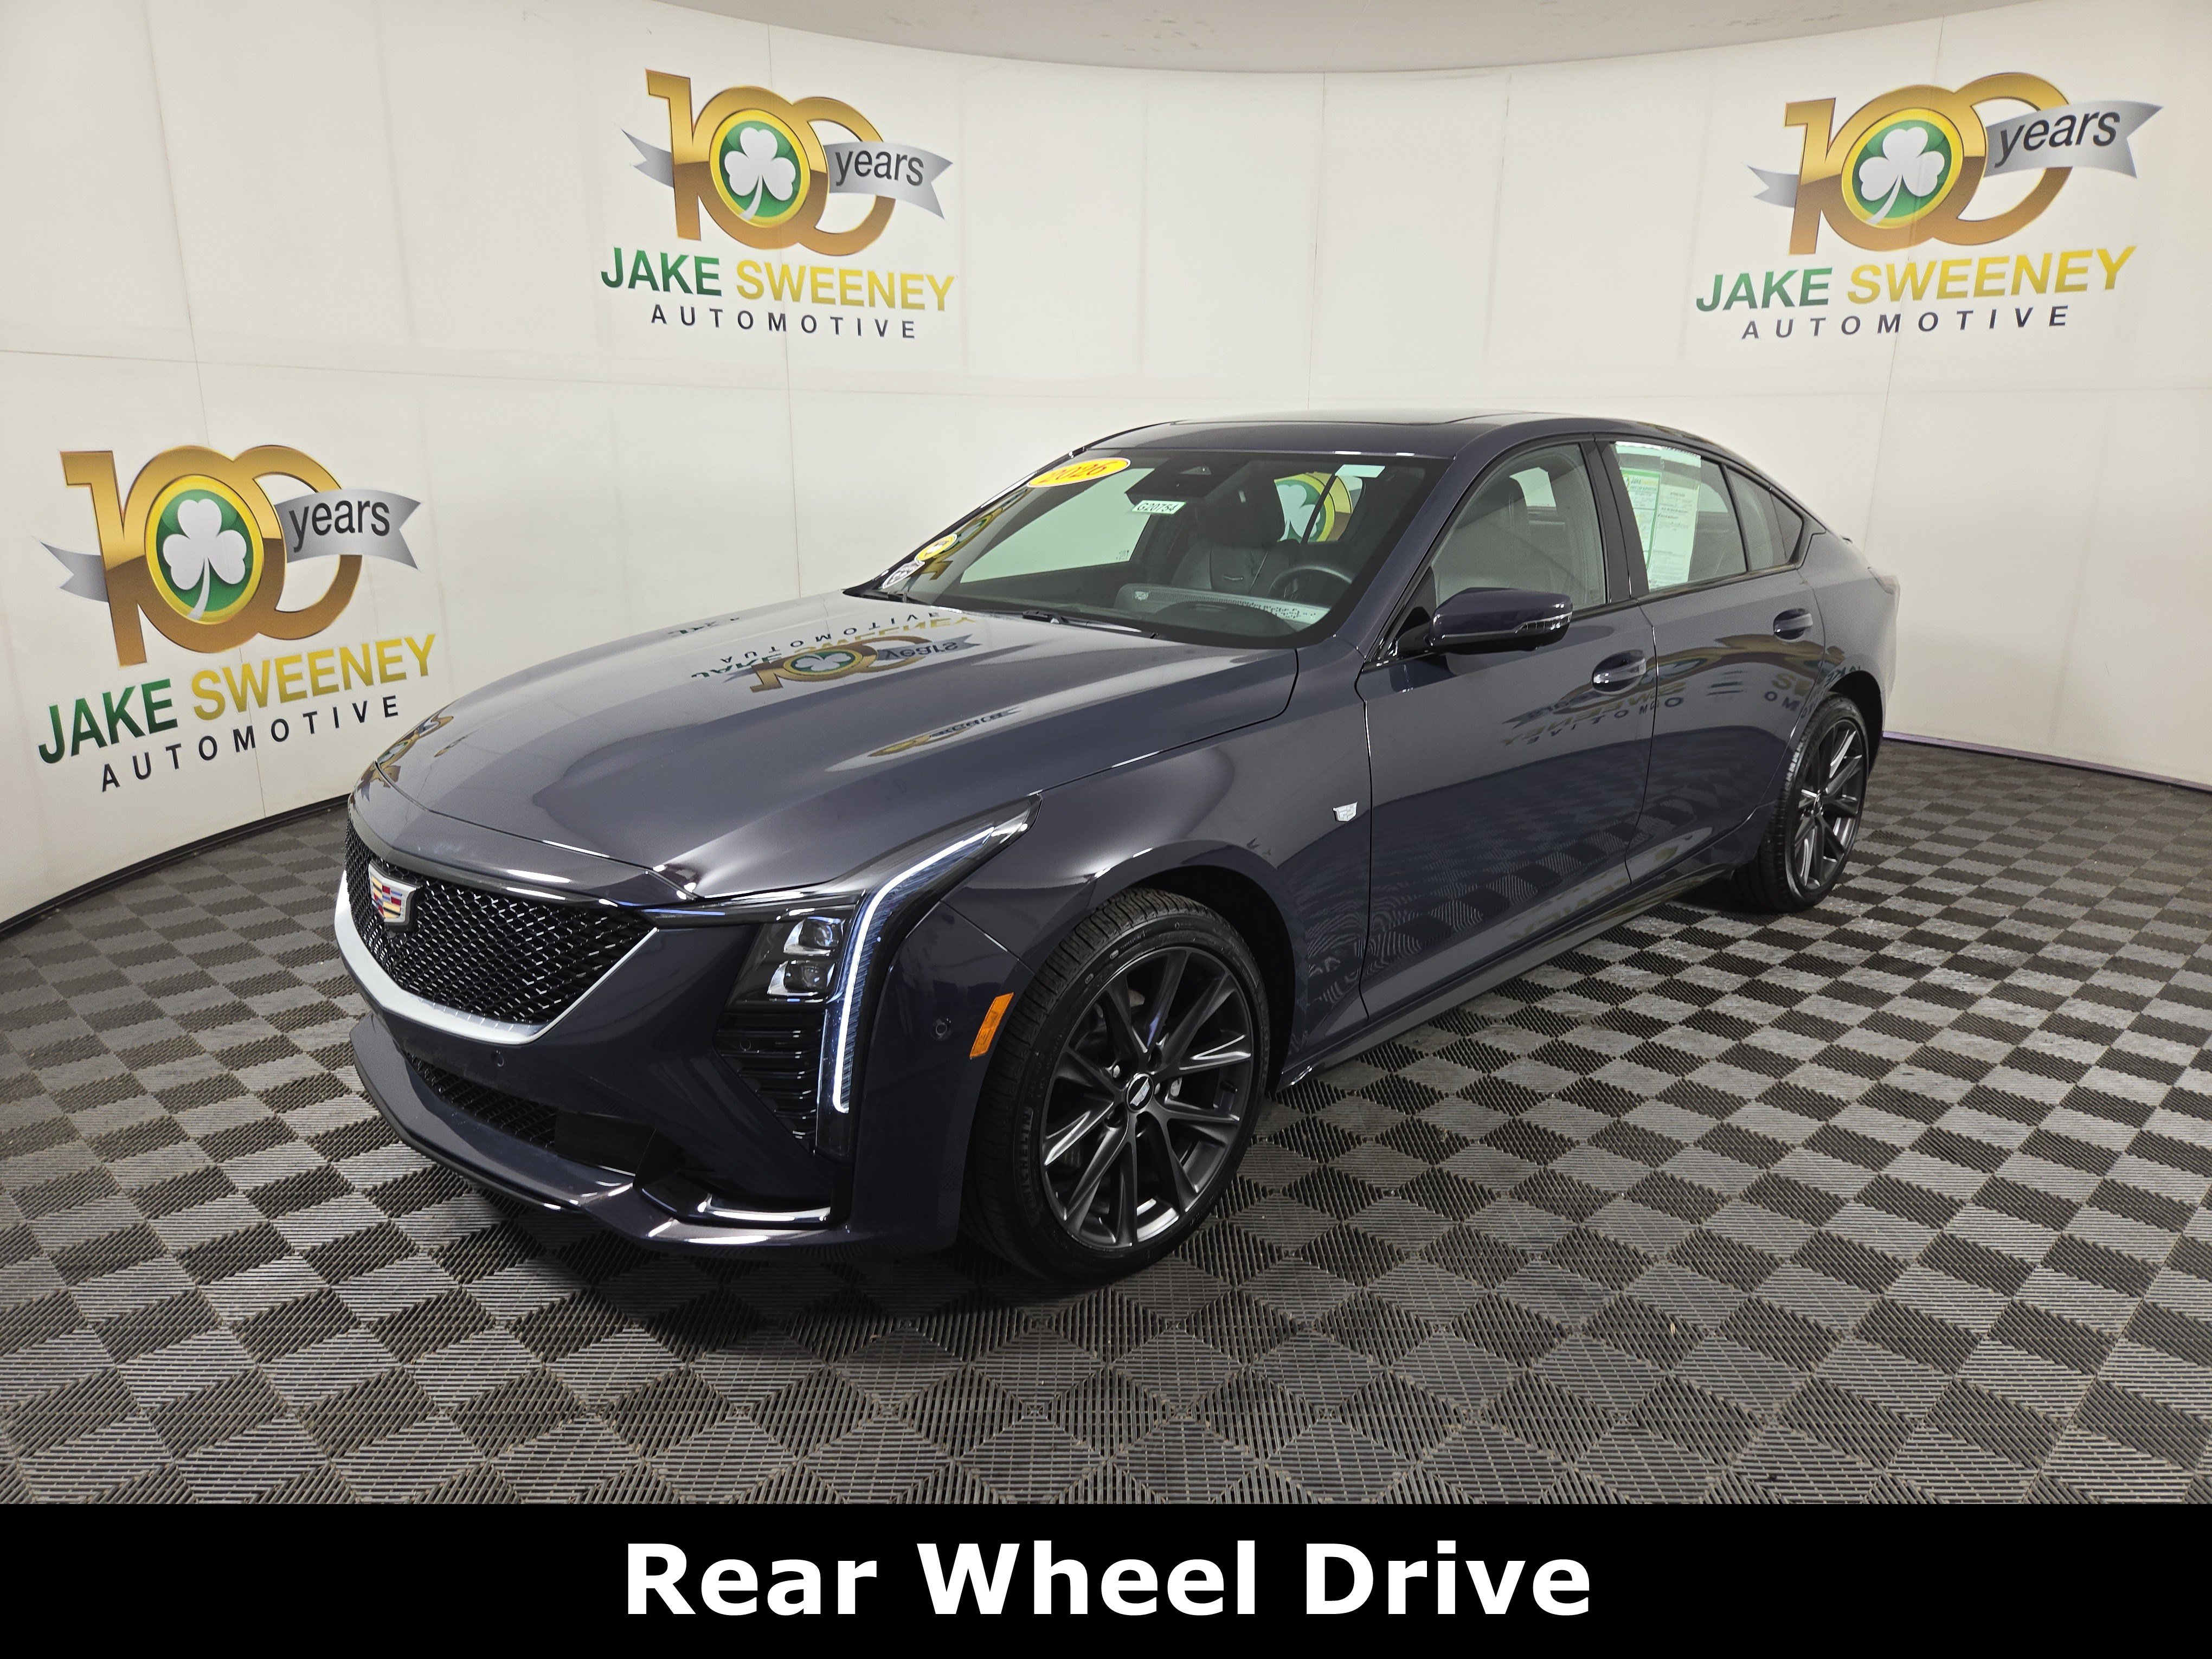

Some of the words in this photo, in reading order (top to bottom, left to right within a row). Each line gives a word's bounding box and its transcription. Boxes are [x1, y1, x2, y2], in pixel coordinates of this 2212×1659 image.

[645, 68, 896, 256] 100
[835, 148, 924, 187] years
[1784, 72, 2073, 255] 100
[1995, 111, 2120, 168] years
[601, 247, 722, 297] JAKE
[736, 260, 956, 311] SWEENEY
[1696, 267, 1833, 312] JAKE
[1847, 246, 2137, 305] SWEENEY
[651, 305, 915, 339] AUTOMOTIVE
[1741, 305, 2068, 340] AUTOMOTIVE
[1039, 462, 1116, 484] 2026
[60, 445, 363, 668] 100
[288, 499, 390, 553] years
[38, 678, 178, 764] JAKE
[191, 633, 436, 721] SWEENEY
[101, 695, 398, 793] AUTOMOTIVE
